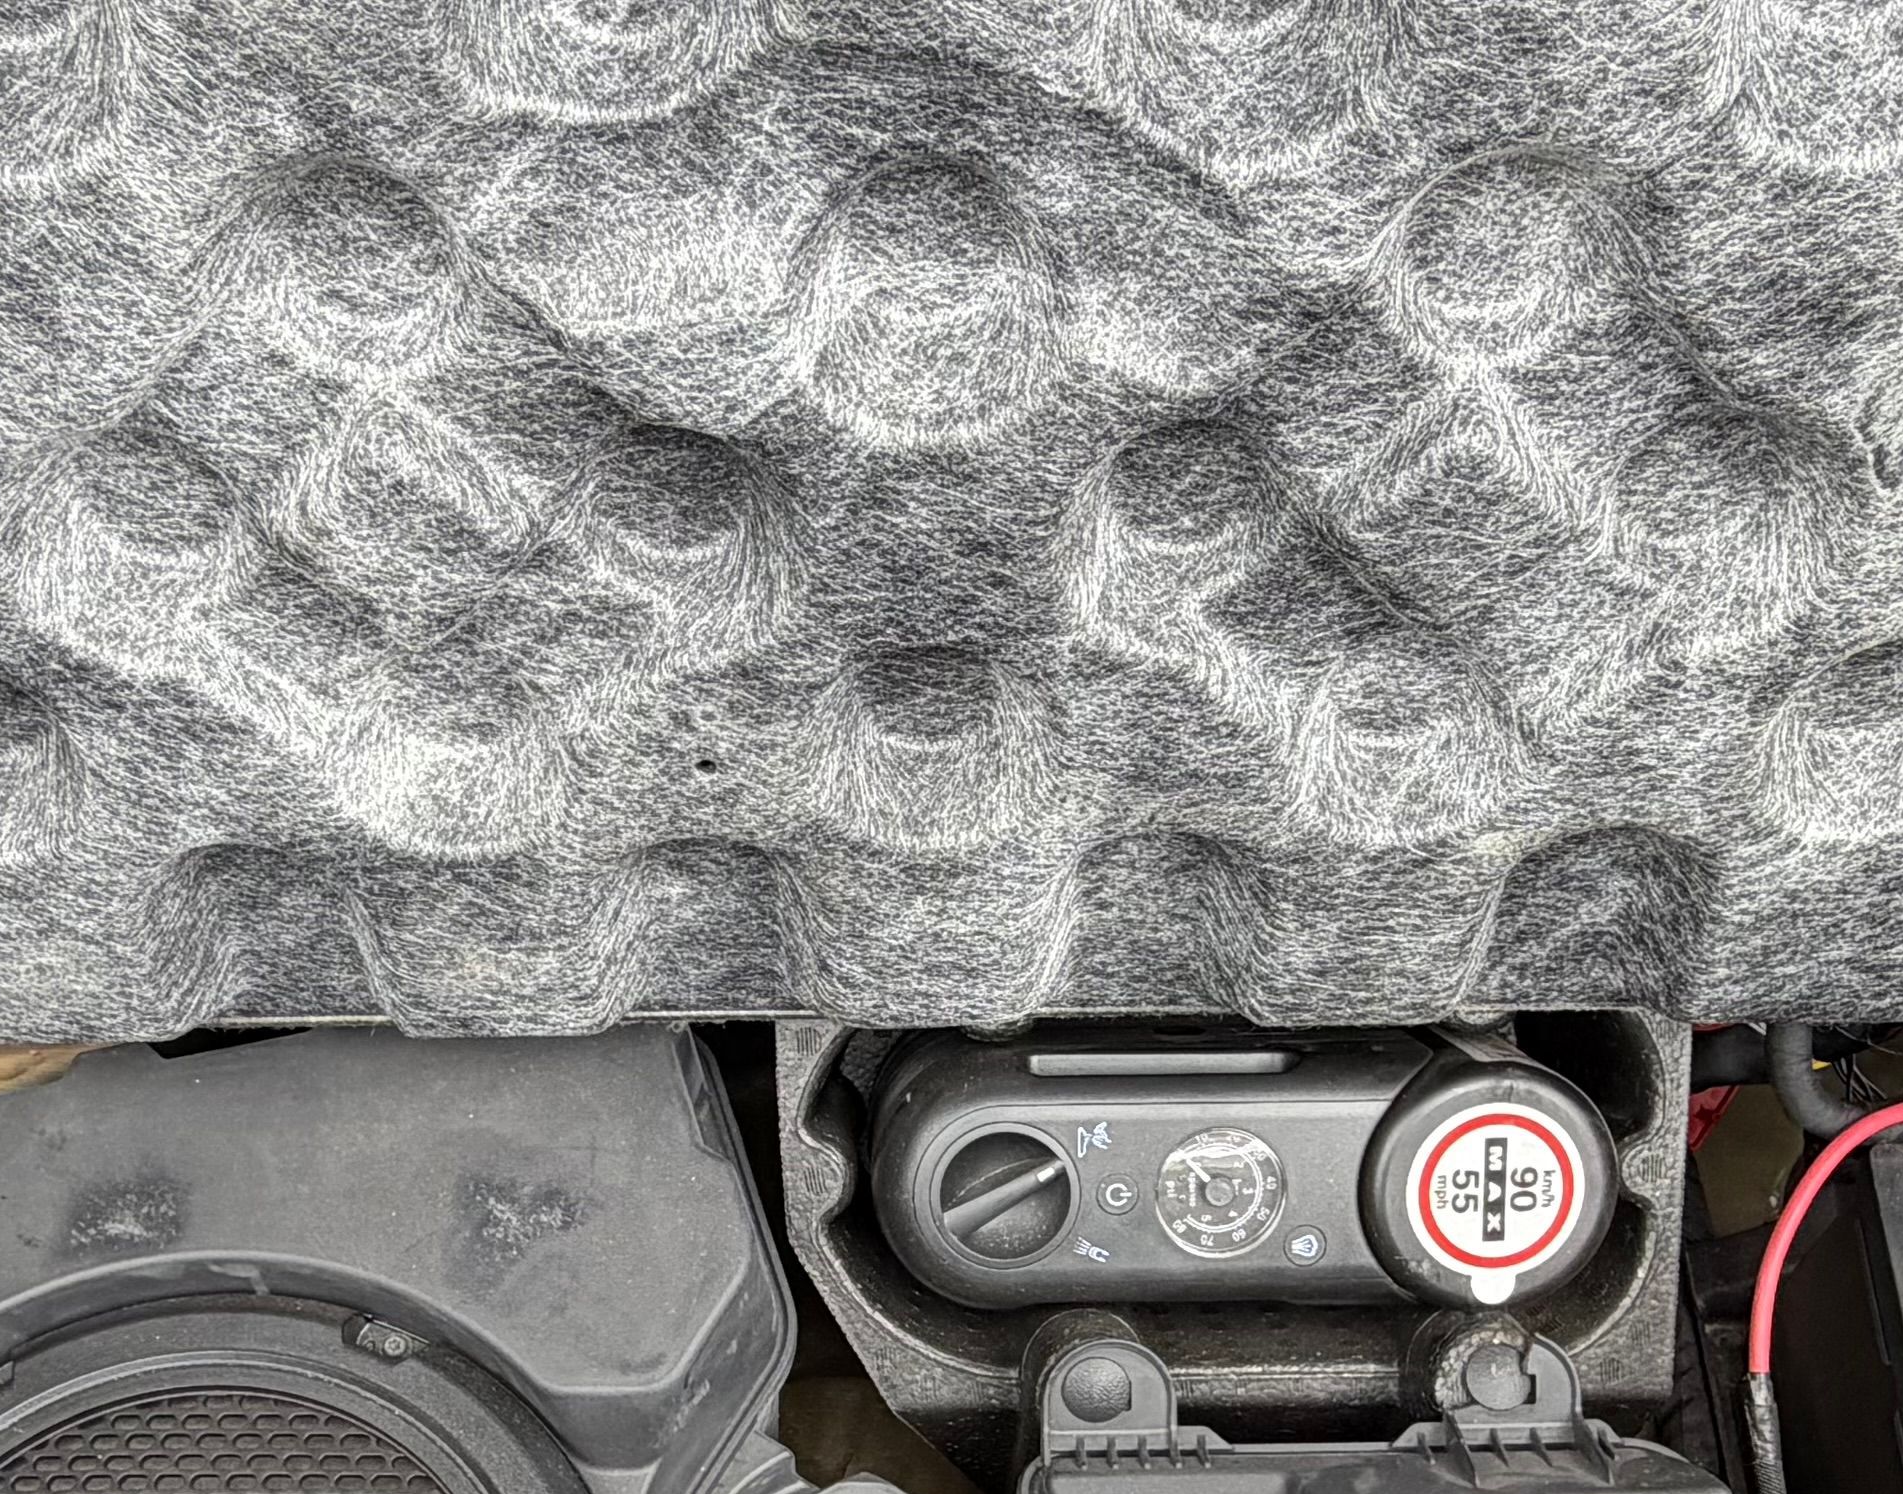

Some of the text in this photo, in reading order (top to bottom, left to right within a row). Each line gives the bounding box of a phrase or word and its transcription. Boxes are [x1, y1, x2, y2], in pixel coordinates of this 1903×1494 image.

[1434, 1175, 1450, 1209] mph
[1452, 1169, 1480, 1213] 55
[1487, 1146, 1503, 1233] MAX
[1510, 1167, 1538, 1212] 90
[1541, 1169, 1556, 1208] km/h
